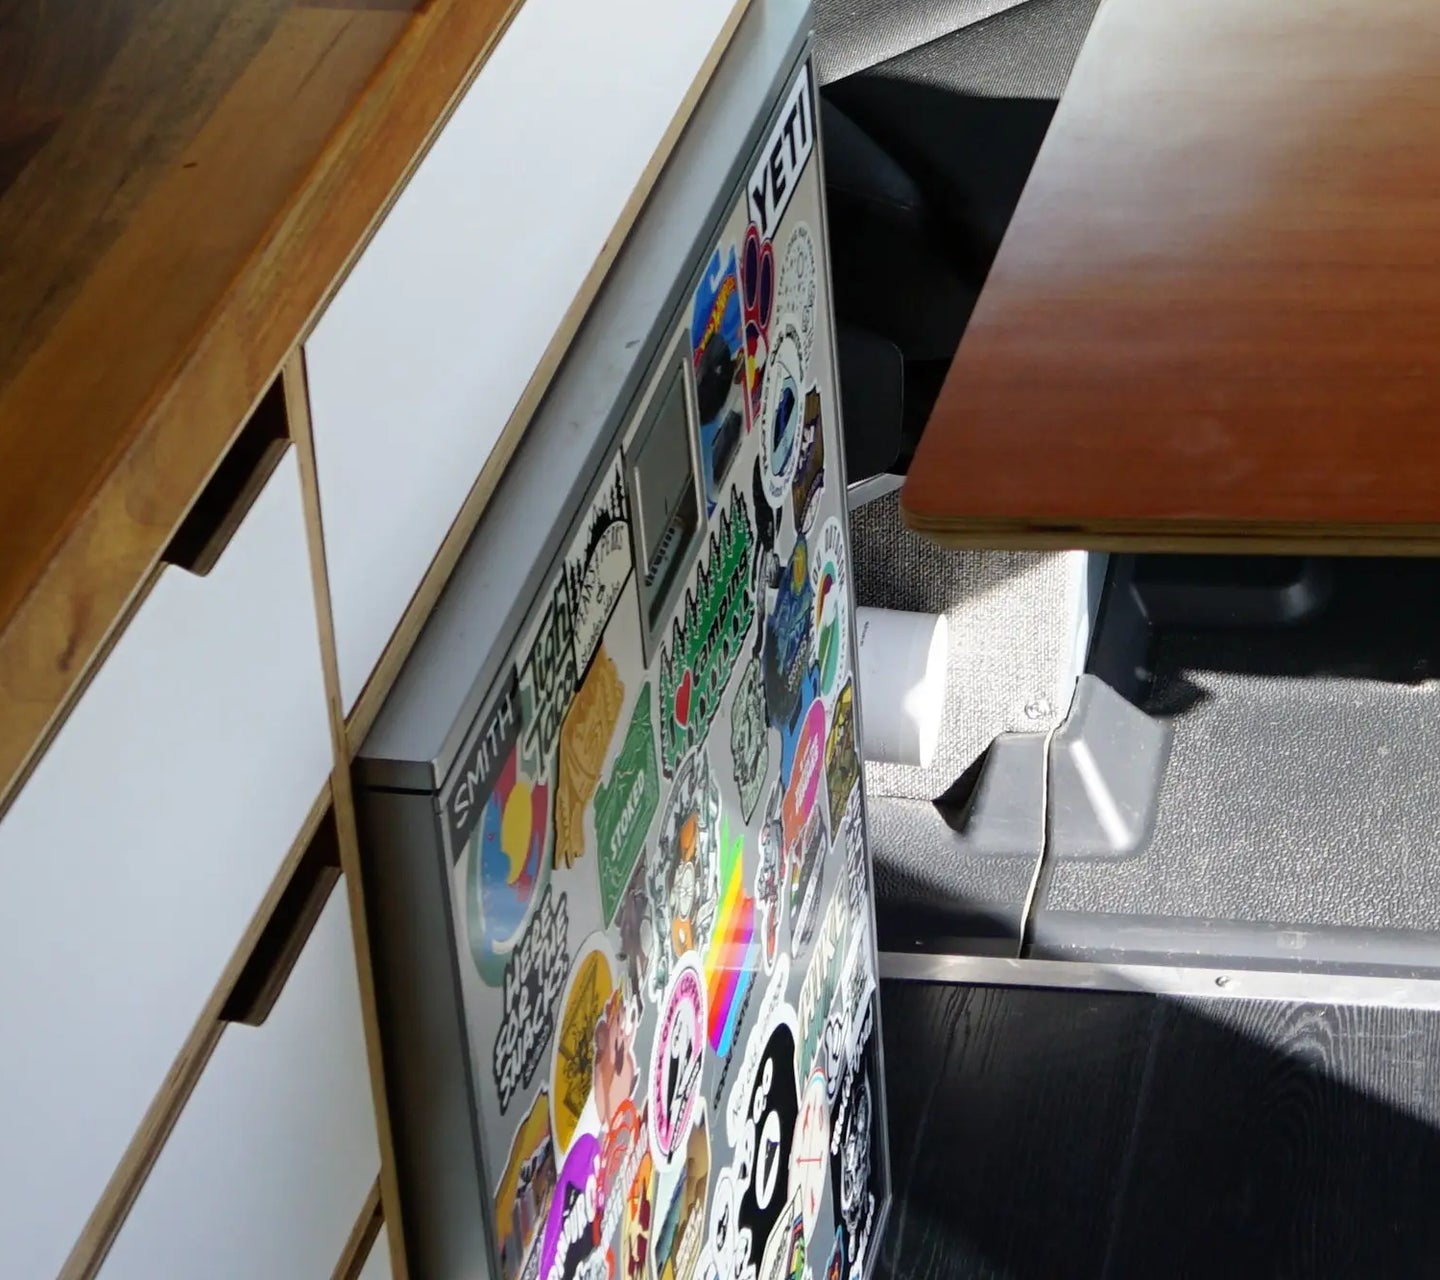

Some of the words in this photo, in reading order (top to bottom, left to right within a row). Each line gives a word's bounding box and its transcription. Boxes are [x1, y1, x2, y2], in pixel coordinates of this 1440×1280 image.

[753, 87, 807, 235] YETI
[517, 573, 574, 704] Tigh
[693, 547, 748, 687] Camping
[454, 693, 514, 829] SMITH
[524, 658, 574, 778] Taco
[610, 770, 646, 861] STOKED
[496, 988, 532, 1077] FOR
[534, 896, 568, 987] THE
[506, 891, 553, 1010] HERE
[802, 877, 847, 1022] HIKE
[500, 950, 569, 1113] SNACKS.
[655, 1051, 666, 1132] BLACK
[662, 994, 679, 1042] OWL
[680, 973, 702, 1017] COFFEE
[713, 1046, 732, 1111] apple
[831, 1004, 873, 1157] Motörhead
